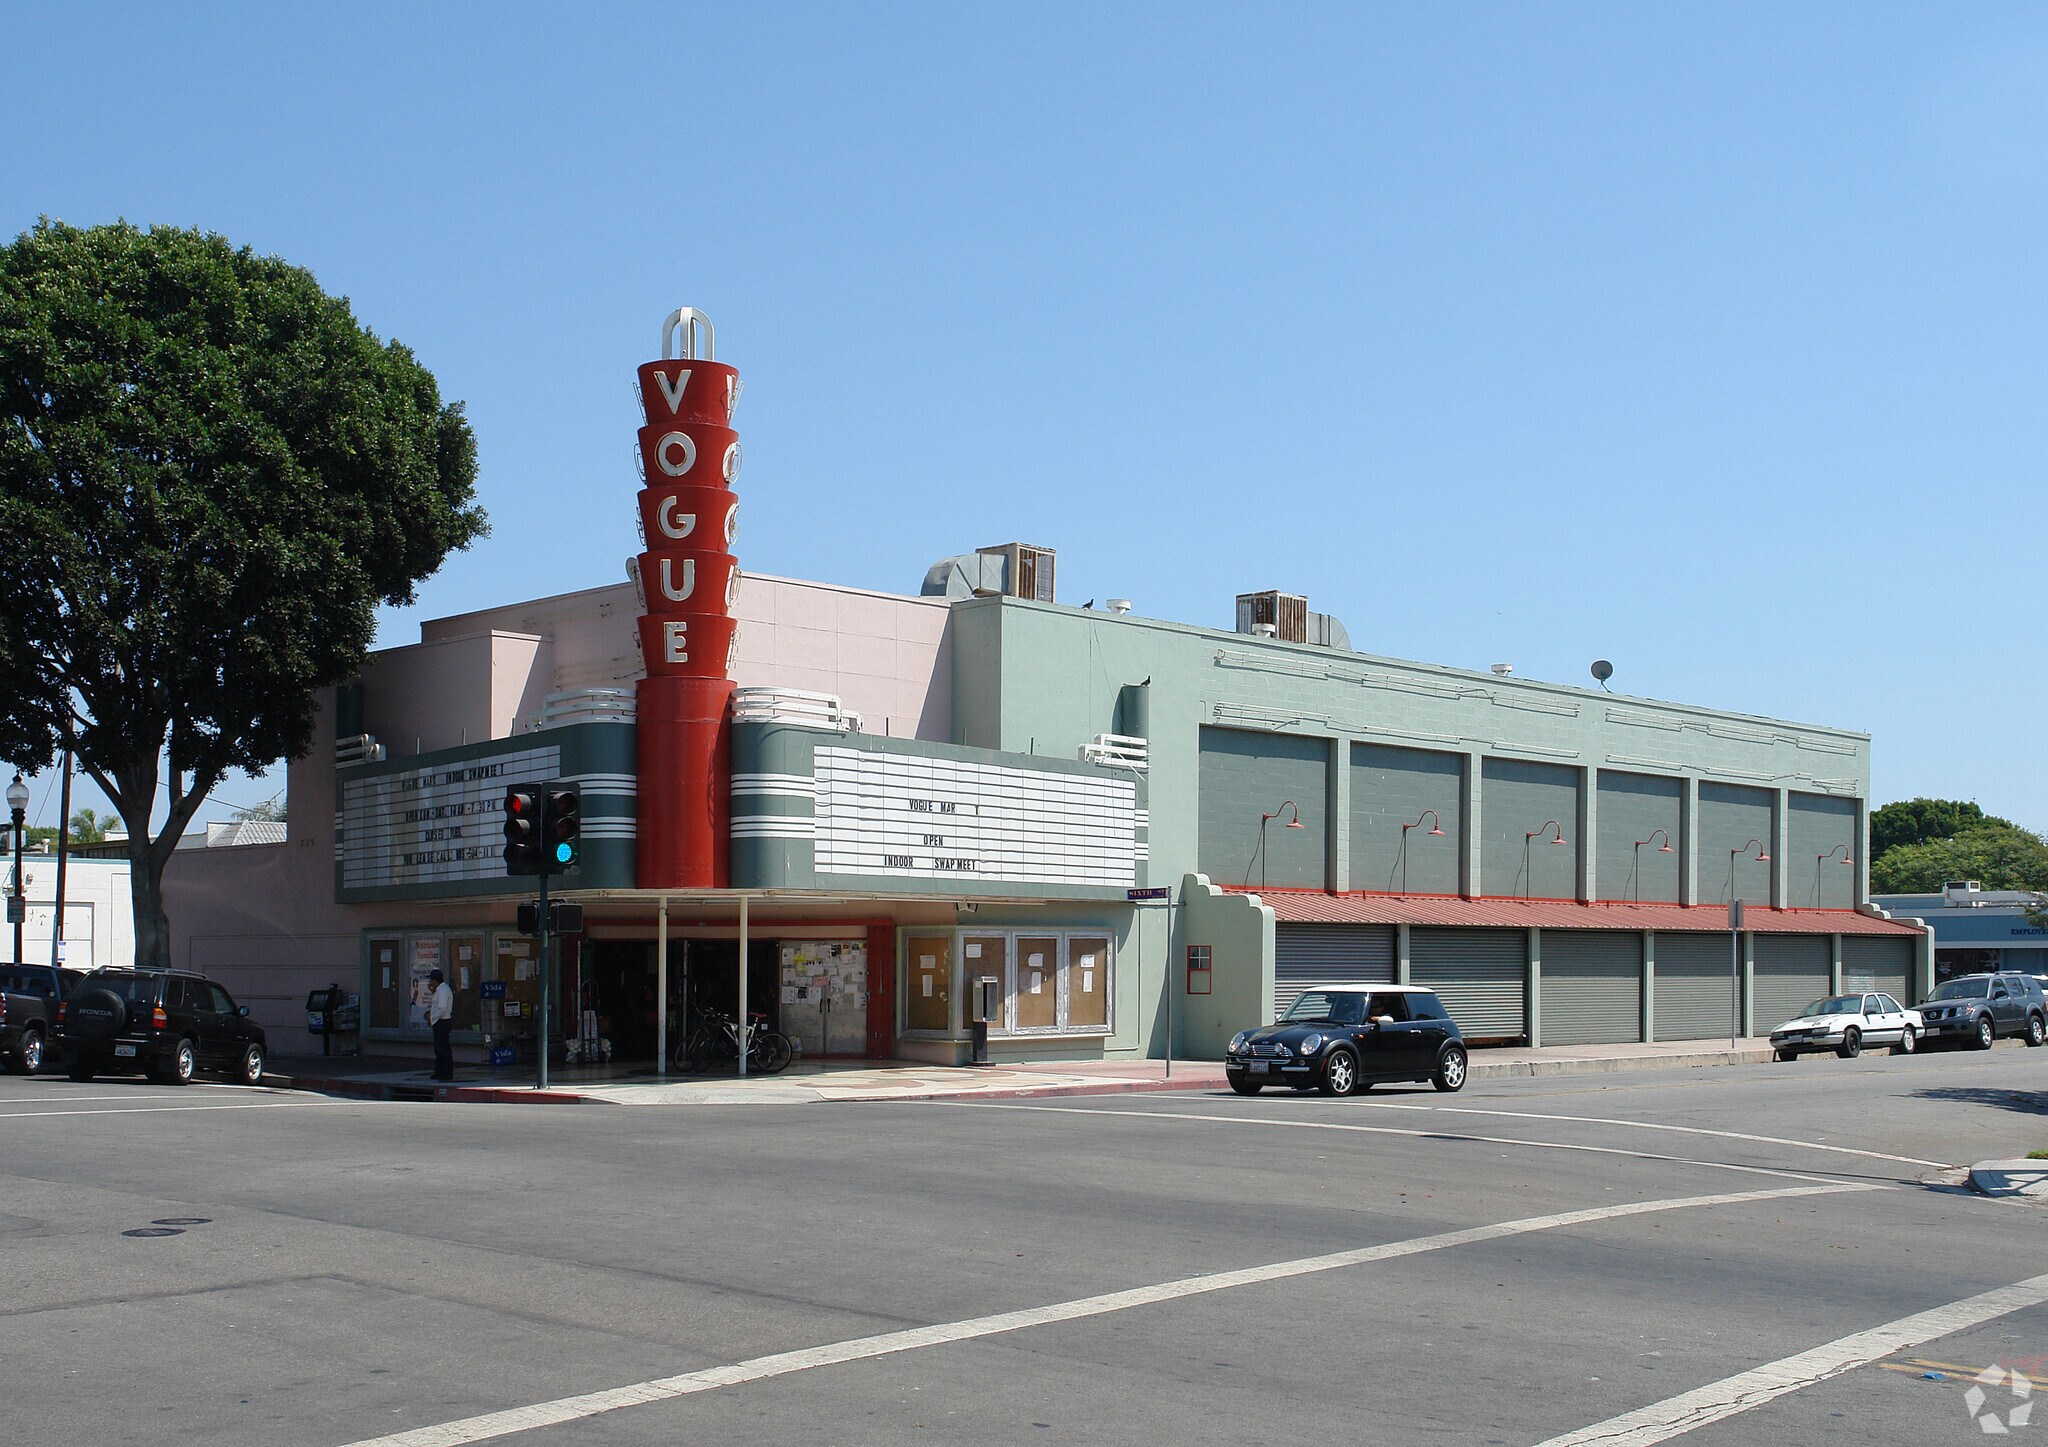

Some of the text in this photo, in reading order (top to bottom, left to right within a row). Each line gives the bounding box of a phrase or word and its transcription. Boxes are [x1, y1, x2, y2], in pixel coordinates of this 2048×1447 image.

[653, 368, 697, 664] VOGUE
[909, 799, 933, 812] VOGUE
[923, 834, 944, 847] OPEN
[884, 854, 976, 871] INDOOR SWAP MEET
[78, 1007, 113, 1017] HONDA
